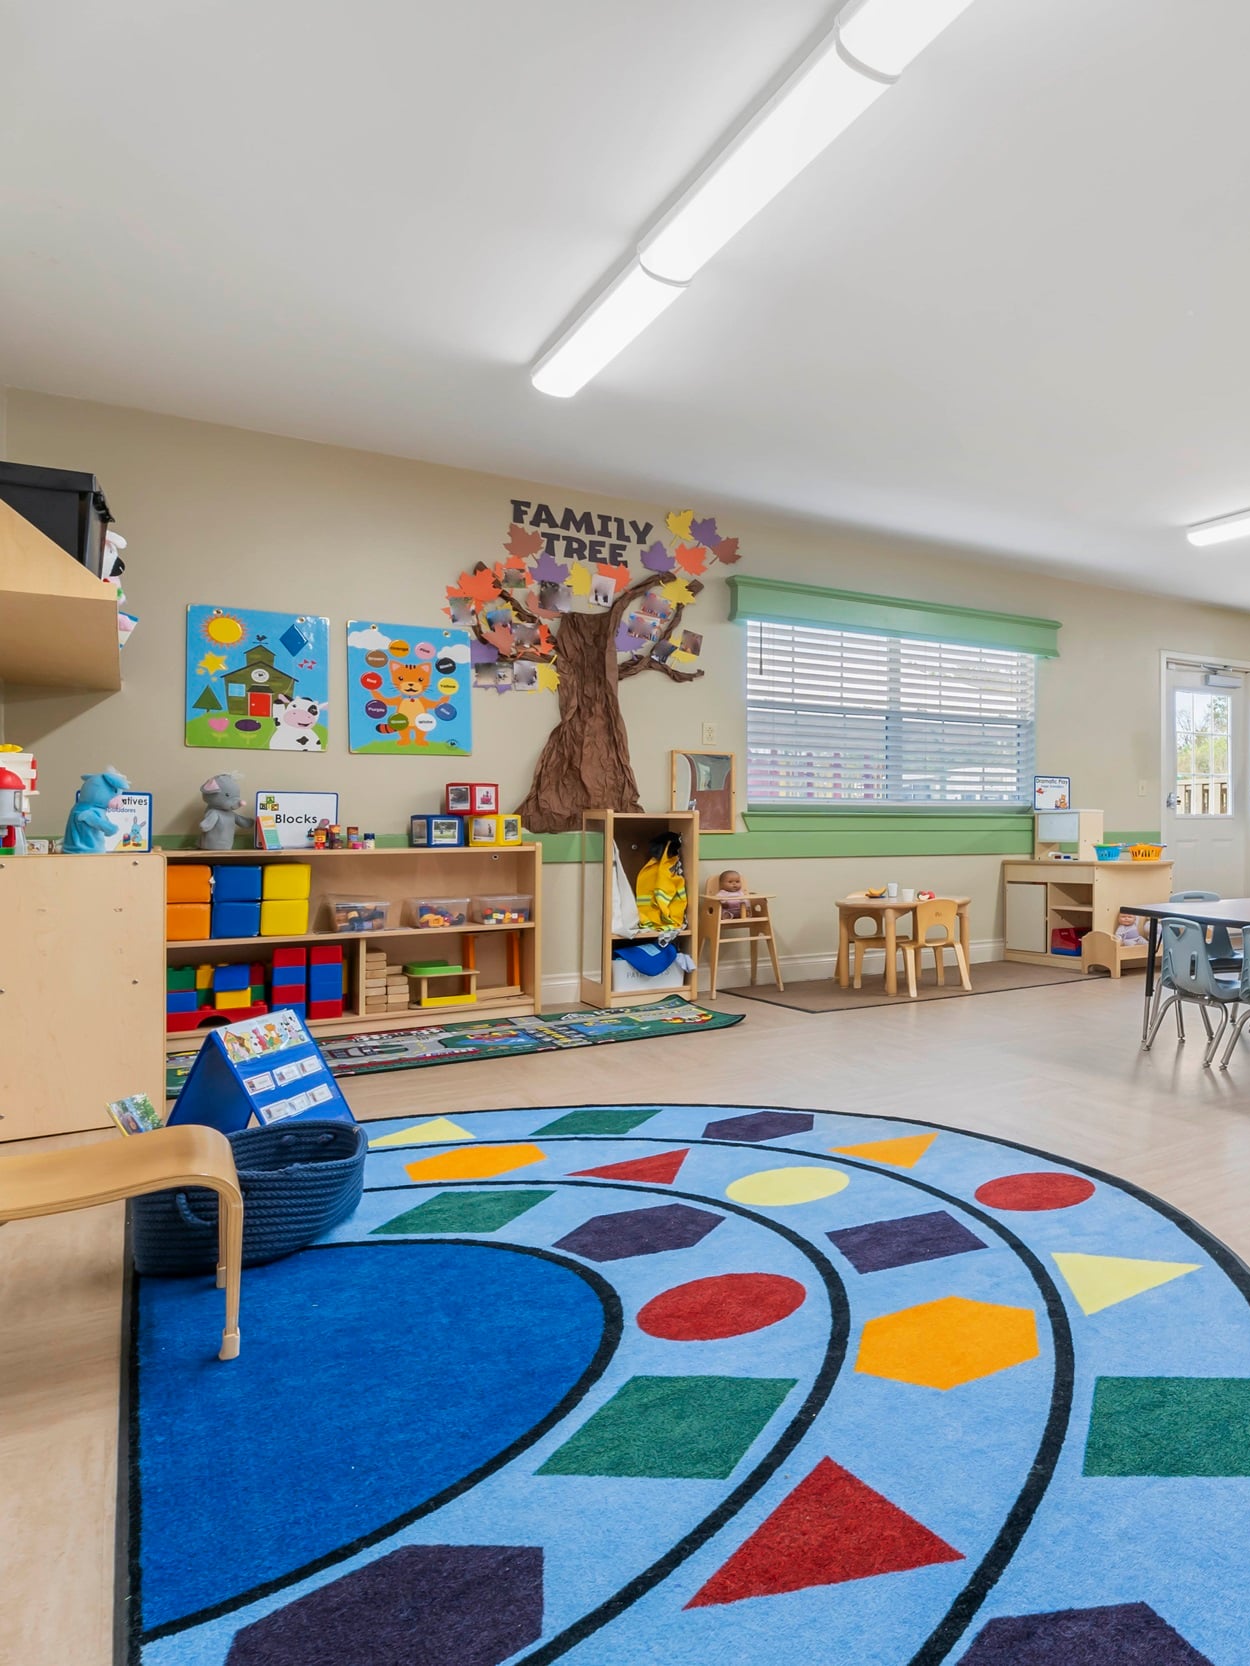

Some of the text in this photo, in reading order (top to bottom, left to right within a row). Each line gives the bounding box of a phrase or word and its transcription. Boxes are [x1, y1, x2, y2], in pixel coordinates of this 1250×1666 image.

[510, 499, 654, 545] FAMILY
[541, 532, 628, 568] TREE
[275, 813, 318, 824] Blocks
